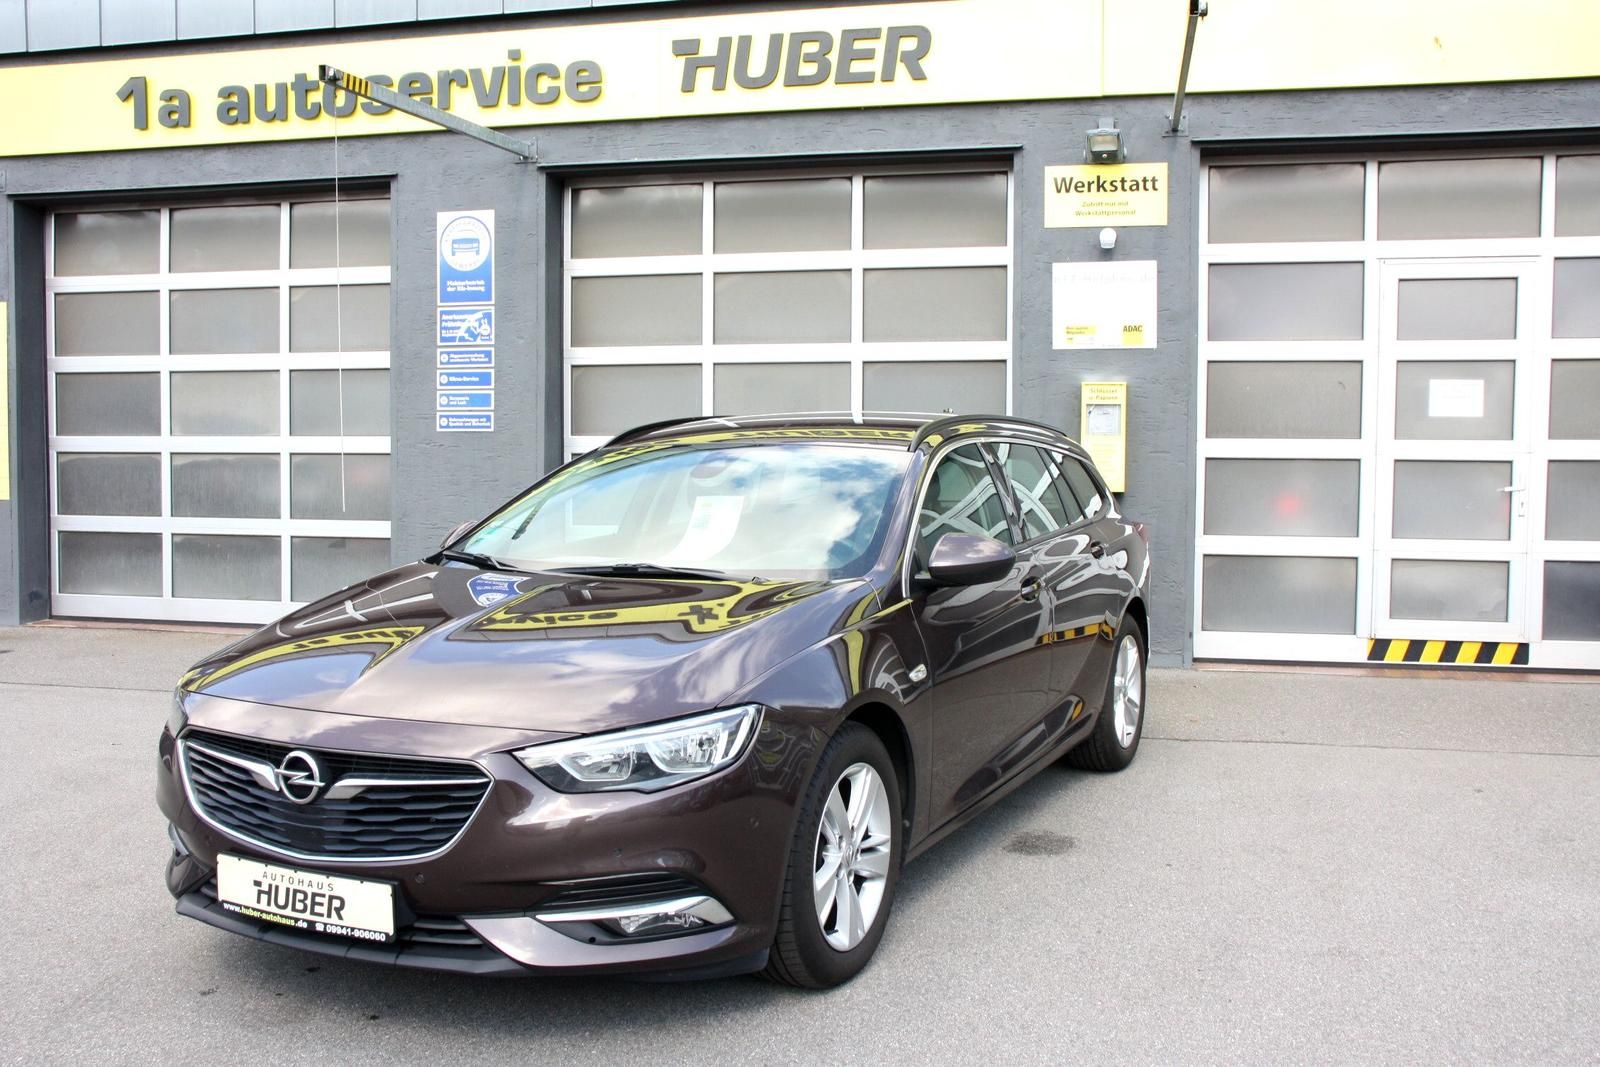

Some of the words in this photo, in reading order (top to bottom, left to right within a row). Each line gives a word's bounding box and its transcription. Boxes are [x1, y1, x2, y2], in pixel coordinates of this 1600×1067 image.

[672, 25, 932, 92] HUBER
[116, 76, 191, 130] 1a
[216, 49, 602, 125] autoservice
[1053, 175, 1159, 193] Werkstatt
[253, 880, 346, 921] HUBER
[262, 870, 334, 892] AUTOHAUS
[223, 902, 308, 929] www.huber-autohaus.de
[326, 924, 386, 942] 09941-906060
